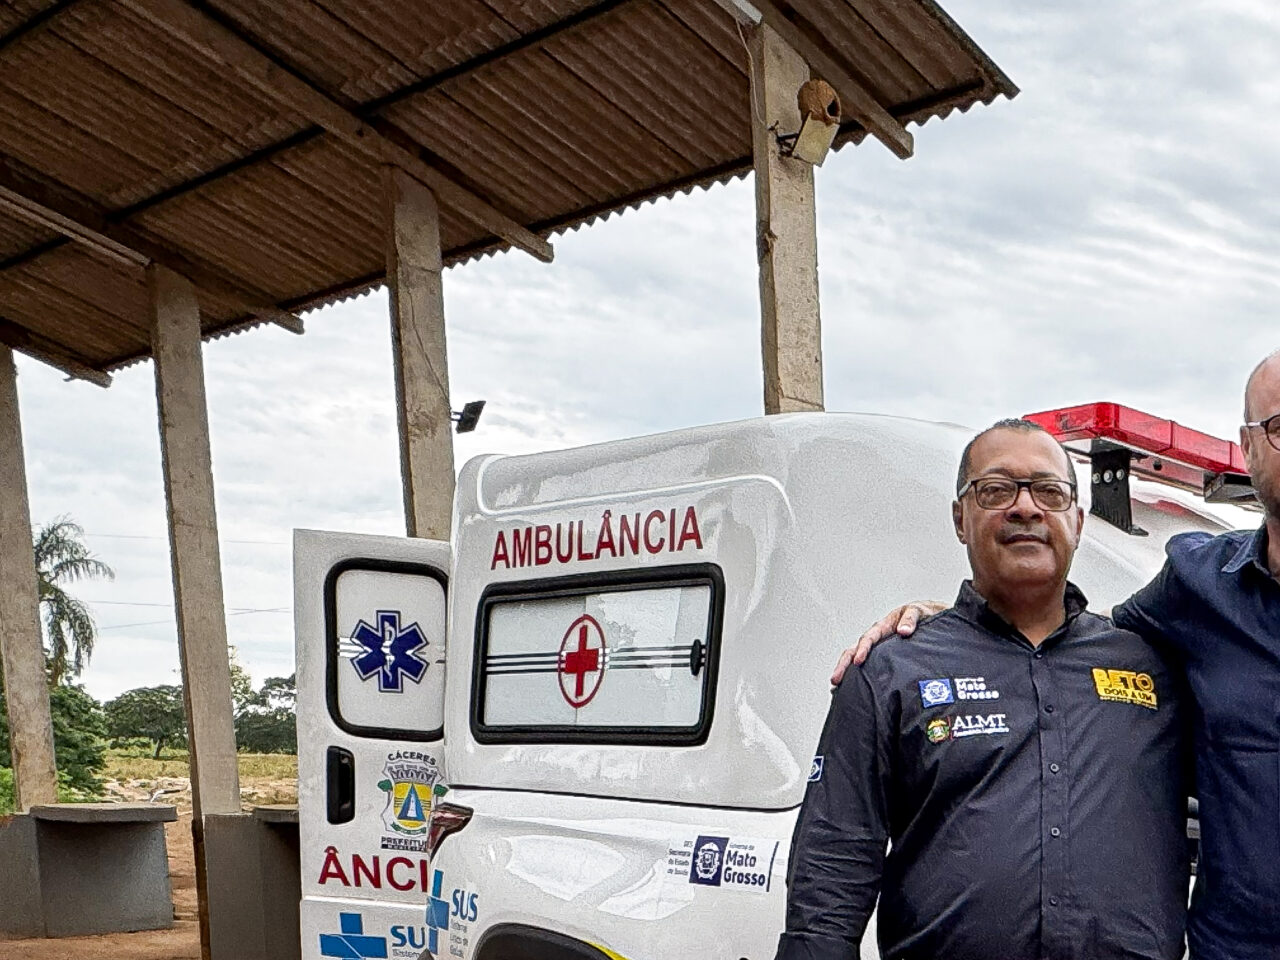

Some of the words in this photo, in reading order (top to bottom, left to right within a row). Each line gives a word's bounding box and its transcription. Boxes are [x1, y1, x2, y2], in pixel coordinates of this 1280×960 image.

[490, 506, 704, 571] AMBULÂNCIA
[956, 682, 987, 691] Mato
[1092, 668, 1154, 692] BETO
[957, 690, 1000, 700] Grosso
[952, 713, 1006, 730] ALMT
[387, 750, 437, 766] CÁCERES
[381, 836, 427, 850] PREFEITU
[725, 850, 757, 868] Mato
[318, 845, 428, 893] ÂNCI
[723, 867, 766, 887] Grosso
[451, 888, 479, 923] SUS
[390, 925, 426, 949] SU
